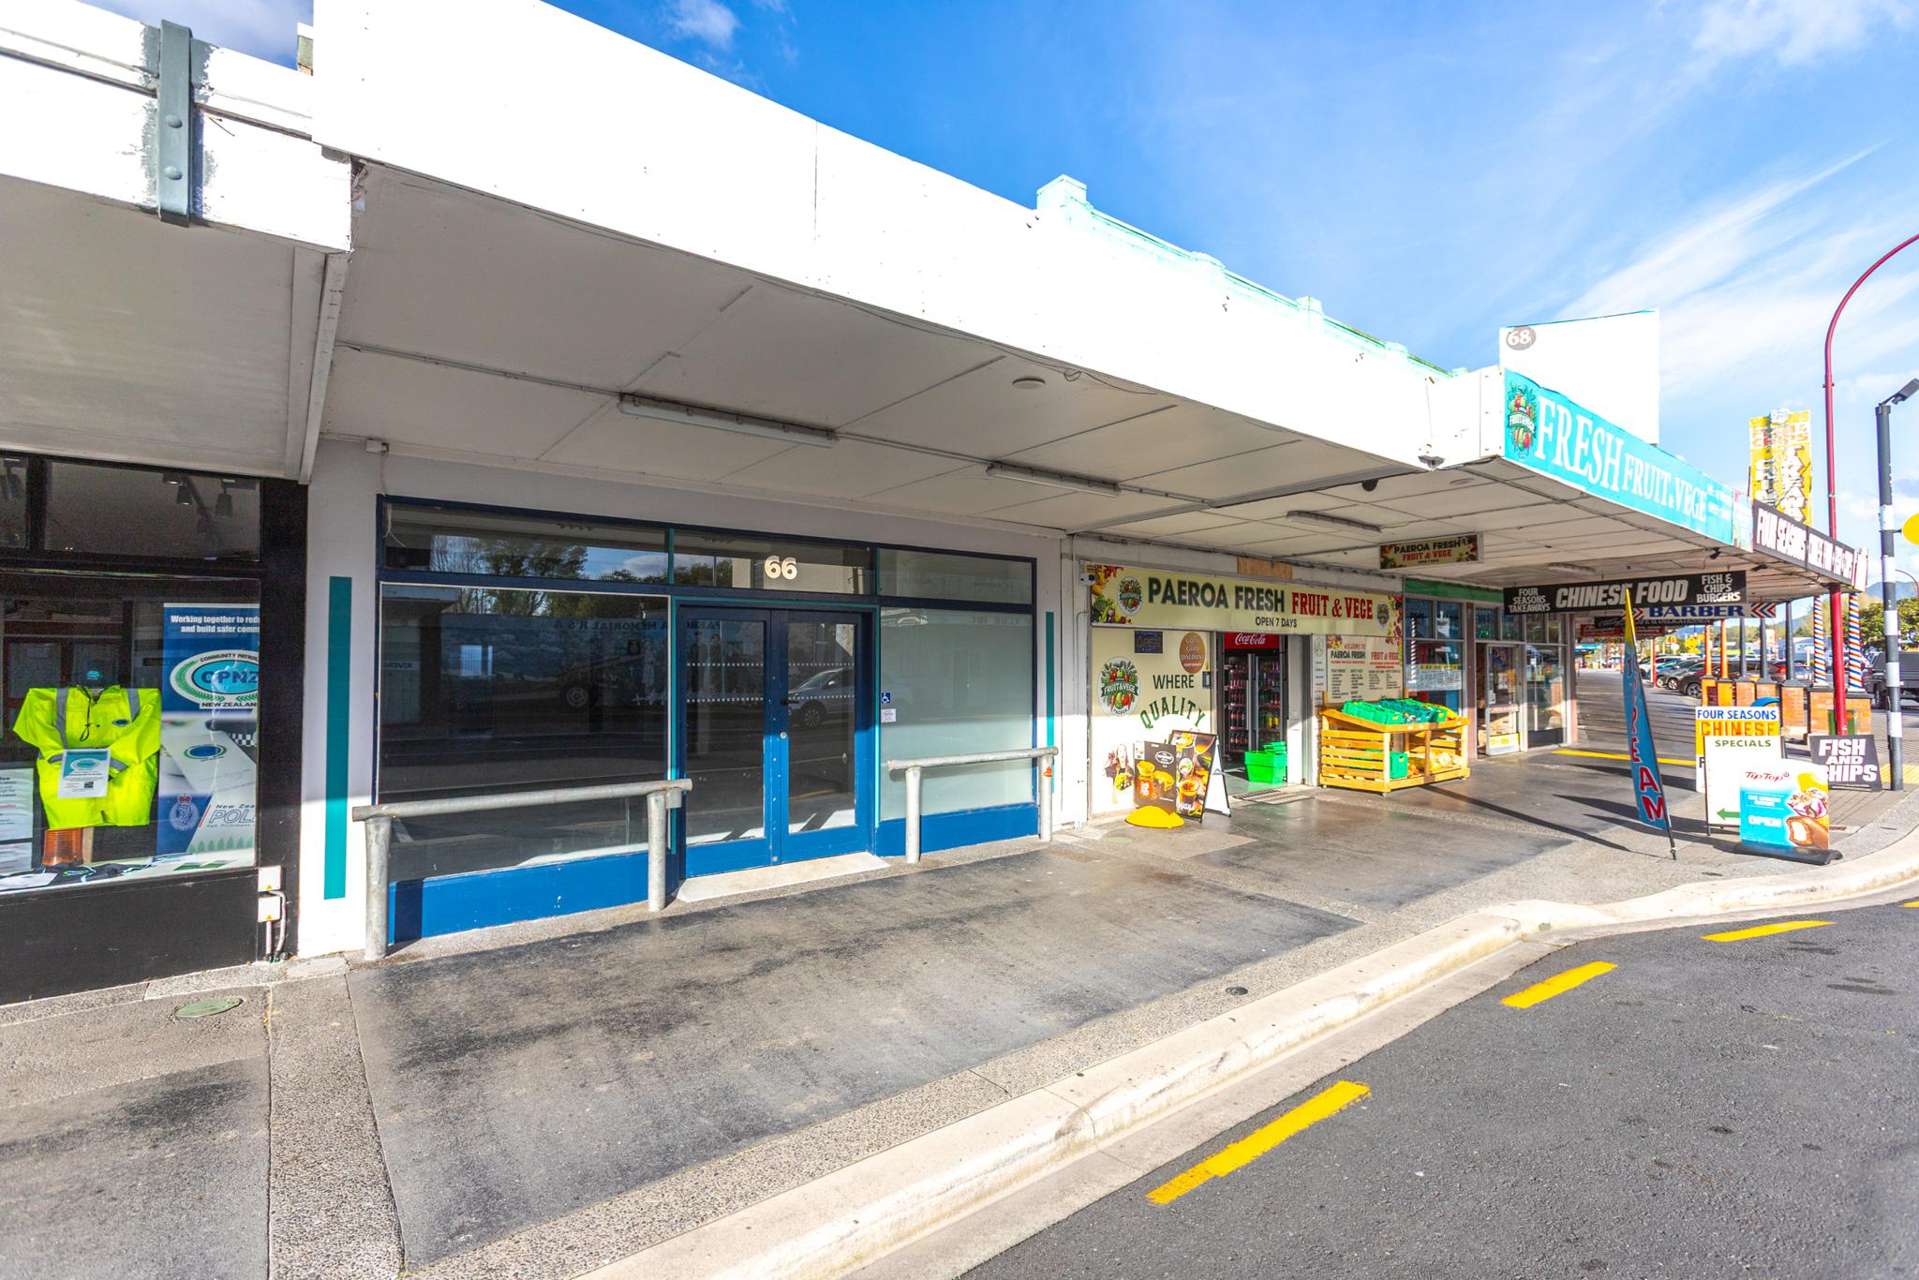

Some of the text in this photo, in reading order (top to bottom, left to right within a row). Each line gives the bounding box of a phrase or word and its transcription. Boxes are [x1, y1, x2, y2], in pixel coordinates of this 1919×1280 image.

[1507, 331, 1532, 346] 68
[1534, 395, 1625, 493] FRESH
[1394, 538, 1461, 554] PAEROA FRESH
[764, 555, 798, 580] 66
[1702, 574, 1733, 585] FISH &
[1636, 580, 1688, 604] FOOD
[1704, 584, 1732, 592] CHIPS
[1148, 577, 1373, 619] PAEROA FRESH FRUIT & VEGE
[1513, 595, 1546, 604] SEASONS
[1697, 592, 1741, 604] BURGERS
[1509, 603, 1551, 613] TAKEAWAYS
[1649, 604, 1744, 618] BARBER
[171, 615, 202, 624] Working
[204, 615, 235, 624] together
[1255, 616, 1297, 628] OPEN 7 DAYS
[201, 670, 257, 683] CPNZ
[1153, 674, 1195, 690] WHERE
[1140, 696, 1205, 729] QUALITY
[1697, 709, 1777, 720] FOUR SEASONS
[1700, 722, 1775, 736] CHINESE
[1714, 739, 1771, 748] SPECIALS
[1819, 738, 1866, 756] FISH
[1825, 756, 1864, 765] AND
[208, 808, 257, 824] POL
